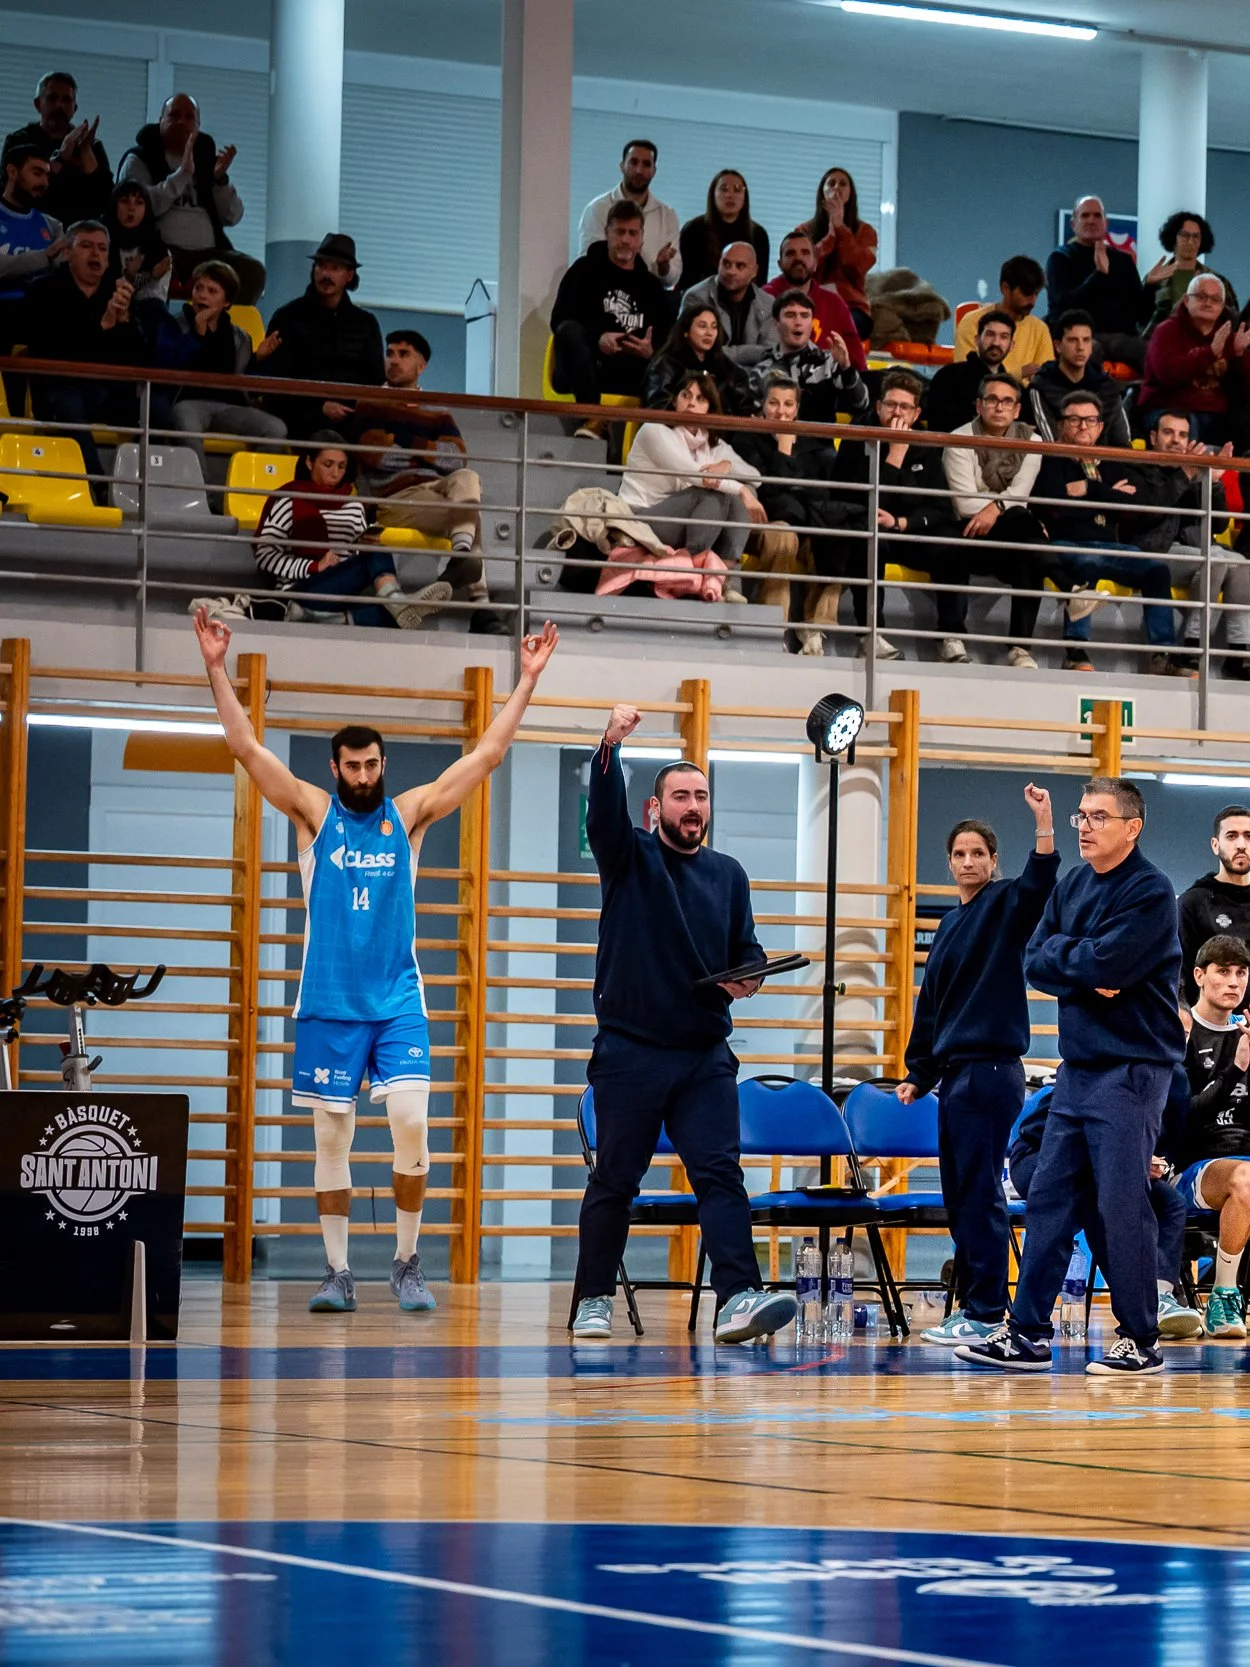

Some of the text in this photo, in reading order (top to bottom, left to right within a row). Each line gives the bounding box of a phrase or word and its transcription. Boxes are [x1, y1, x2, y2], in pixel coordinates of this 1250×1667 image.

[345, 850, 396, 868] Class
[352, 887, 370, 911] 14
[54, 1104, 131, 1131] BÀSQUET
[20, 1154, 158, 1190] SANT ANTONI
[73, 1225, 99, 1237] 1998
